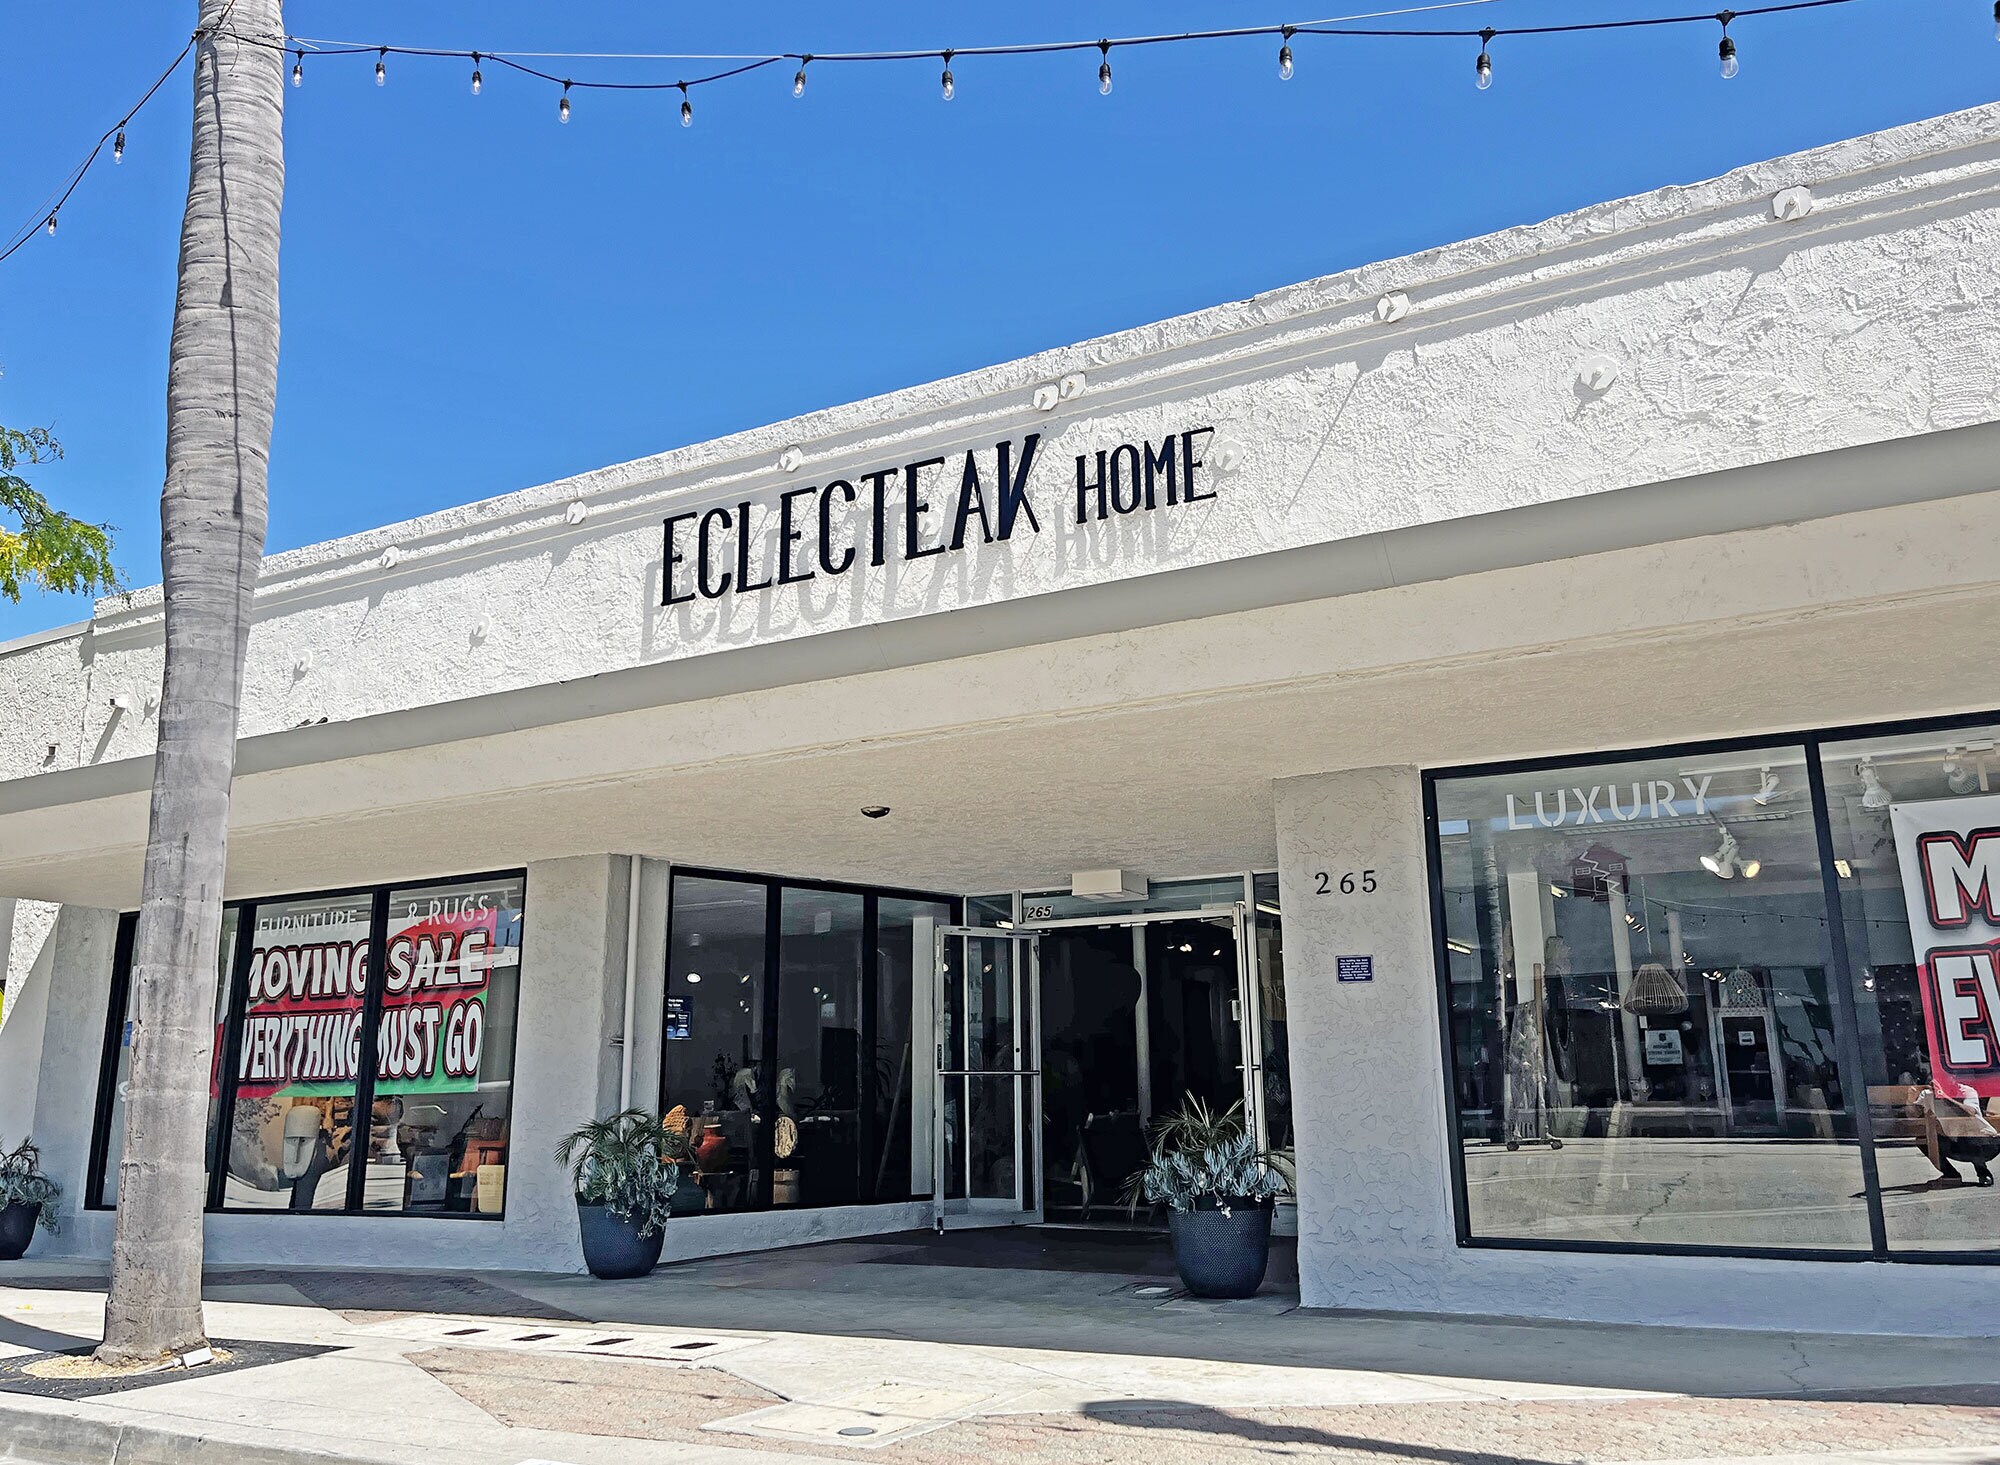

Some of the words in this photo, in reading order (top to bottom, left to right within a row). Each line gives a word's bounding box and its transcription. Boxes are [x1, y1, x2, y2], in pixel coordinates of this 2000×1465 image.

[661, 433, 1041, 607] ECLECTEAK
[1076, 427, 1217, 524] HOME
[1506, 775, 1713, 831] LUXURY
[1315, 870, 1377, 895] 265
[259, 909, 358, 938] FURNITURE
[428, 895, 490, 926] RUGS
[1027, 906, 1052, 919] 265
[386, 932, 487, 992] SALE
[238, 1011, 364, 1080] VERYTHING
[447, 1002, 483, 1075] GO
